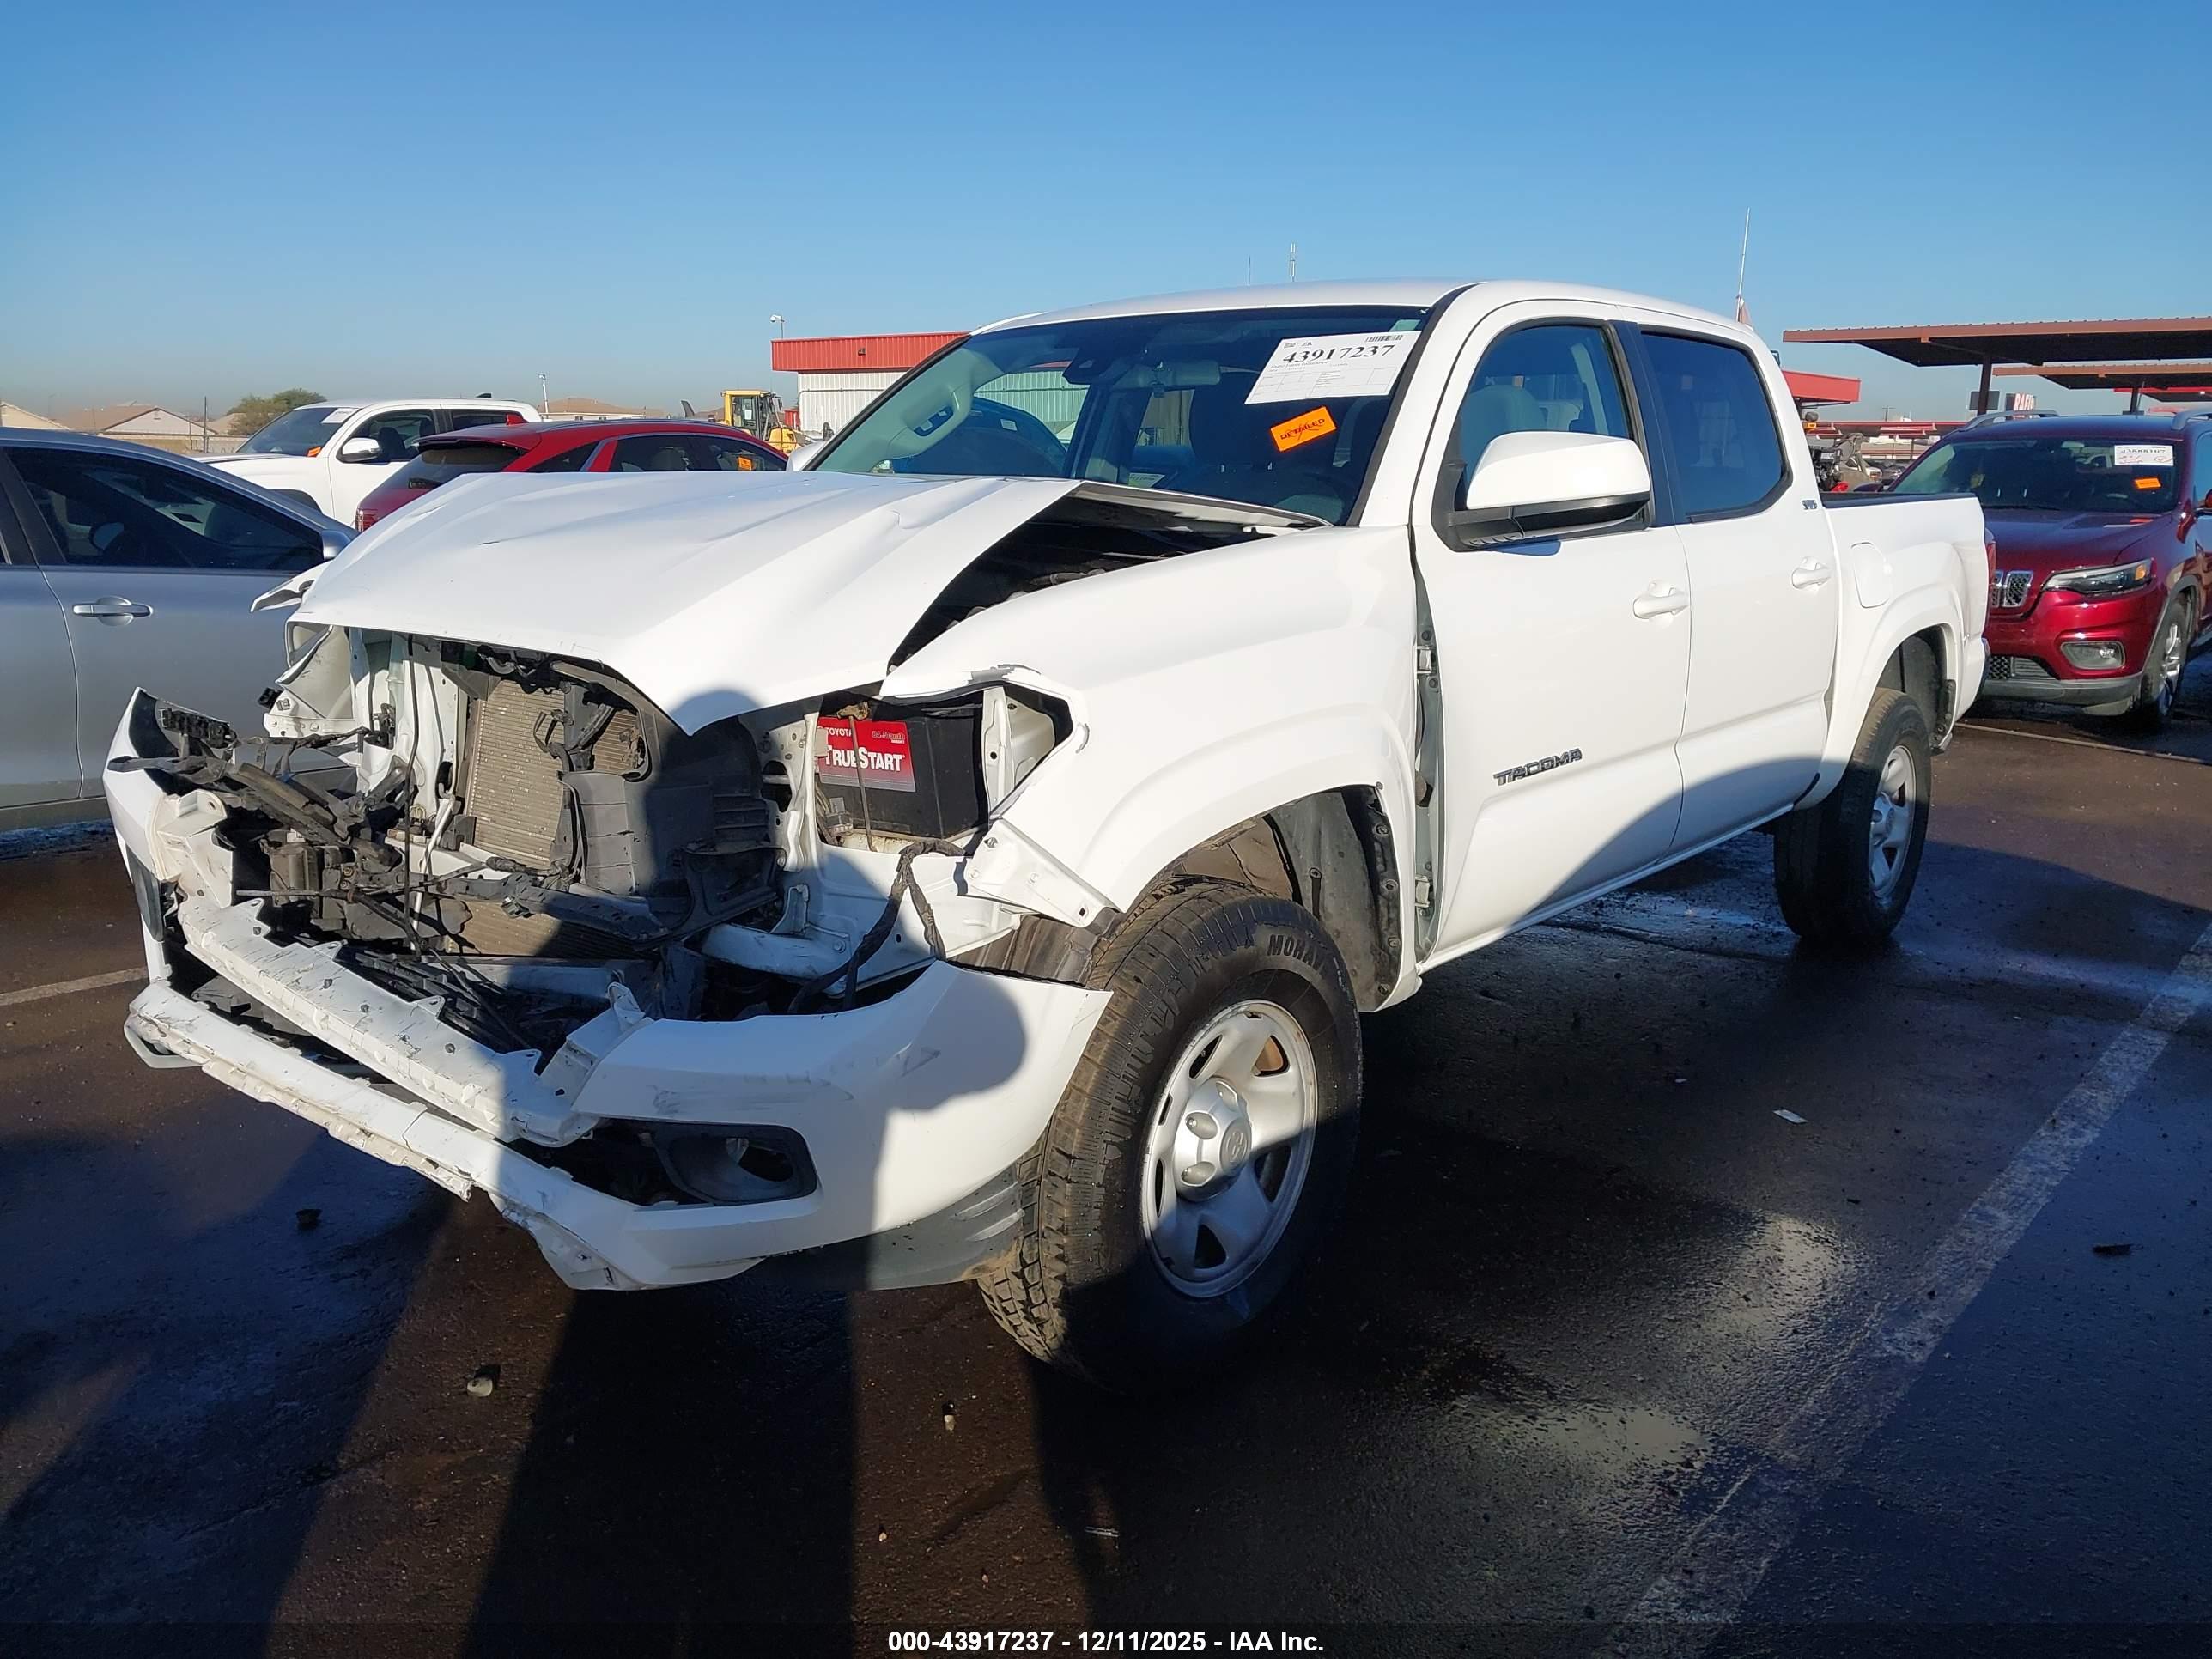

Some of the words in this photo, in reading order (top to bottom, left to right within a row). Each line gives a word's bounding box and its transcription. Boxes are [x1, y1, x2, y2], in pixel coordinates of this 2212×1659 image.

[1283, 344, 1395, 363] 43917237
[1280, 418, 1325, 440] DETAILED
[1493, 748, 1582, 786] TACOMA
